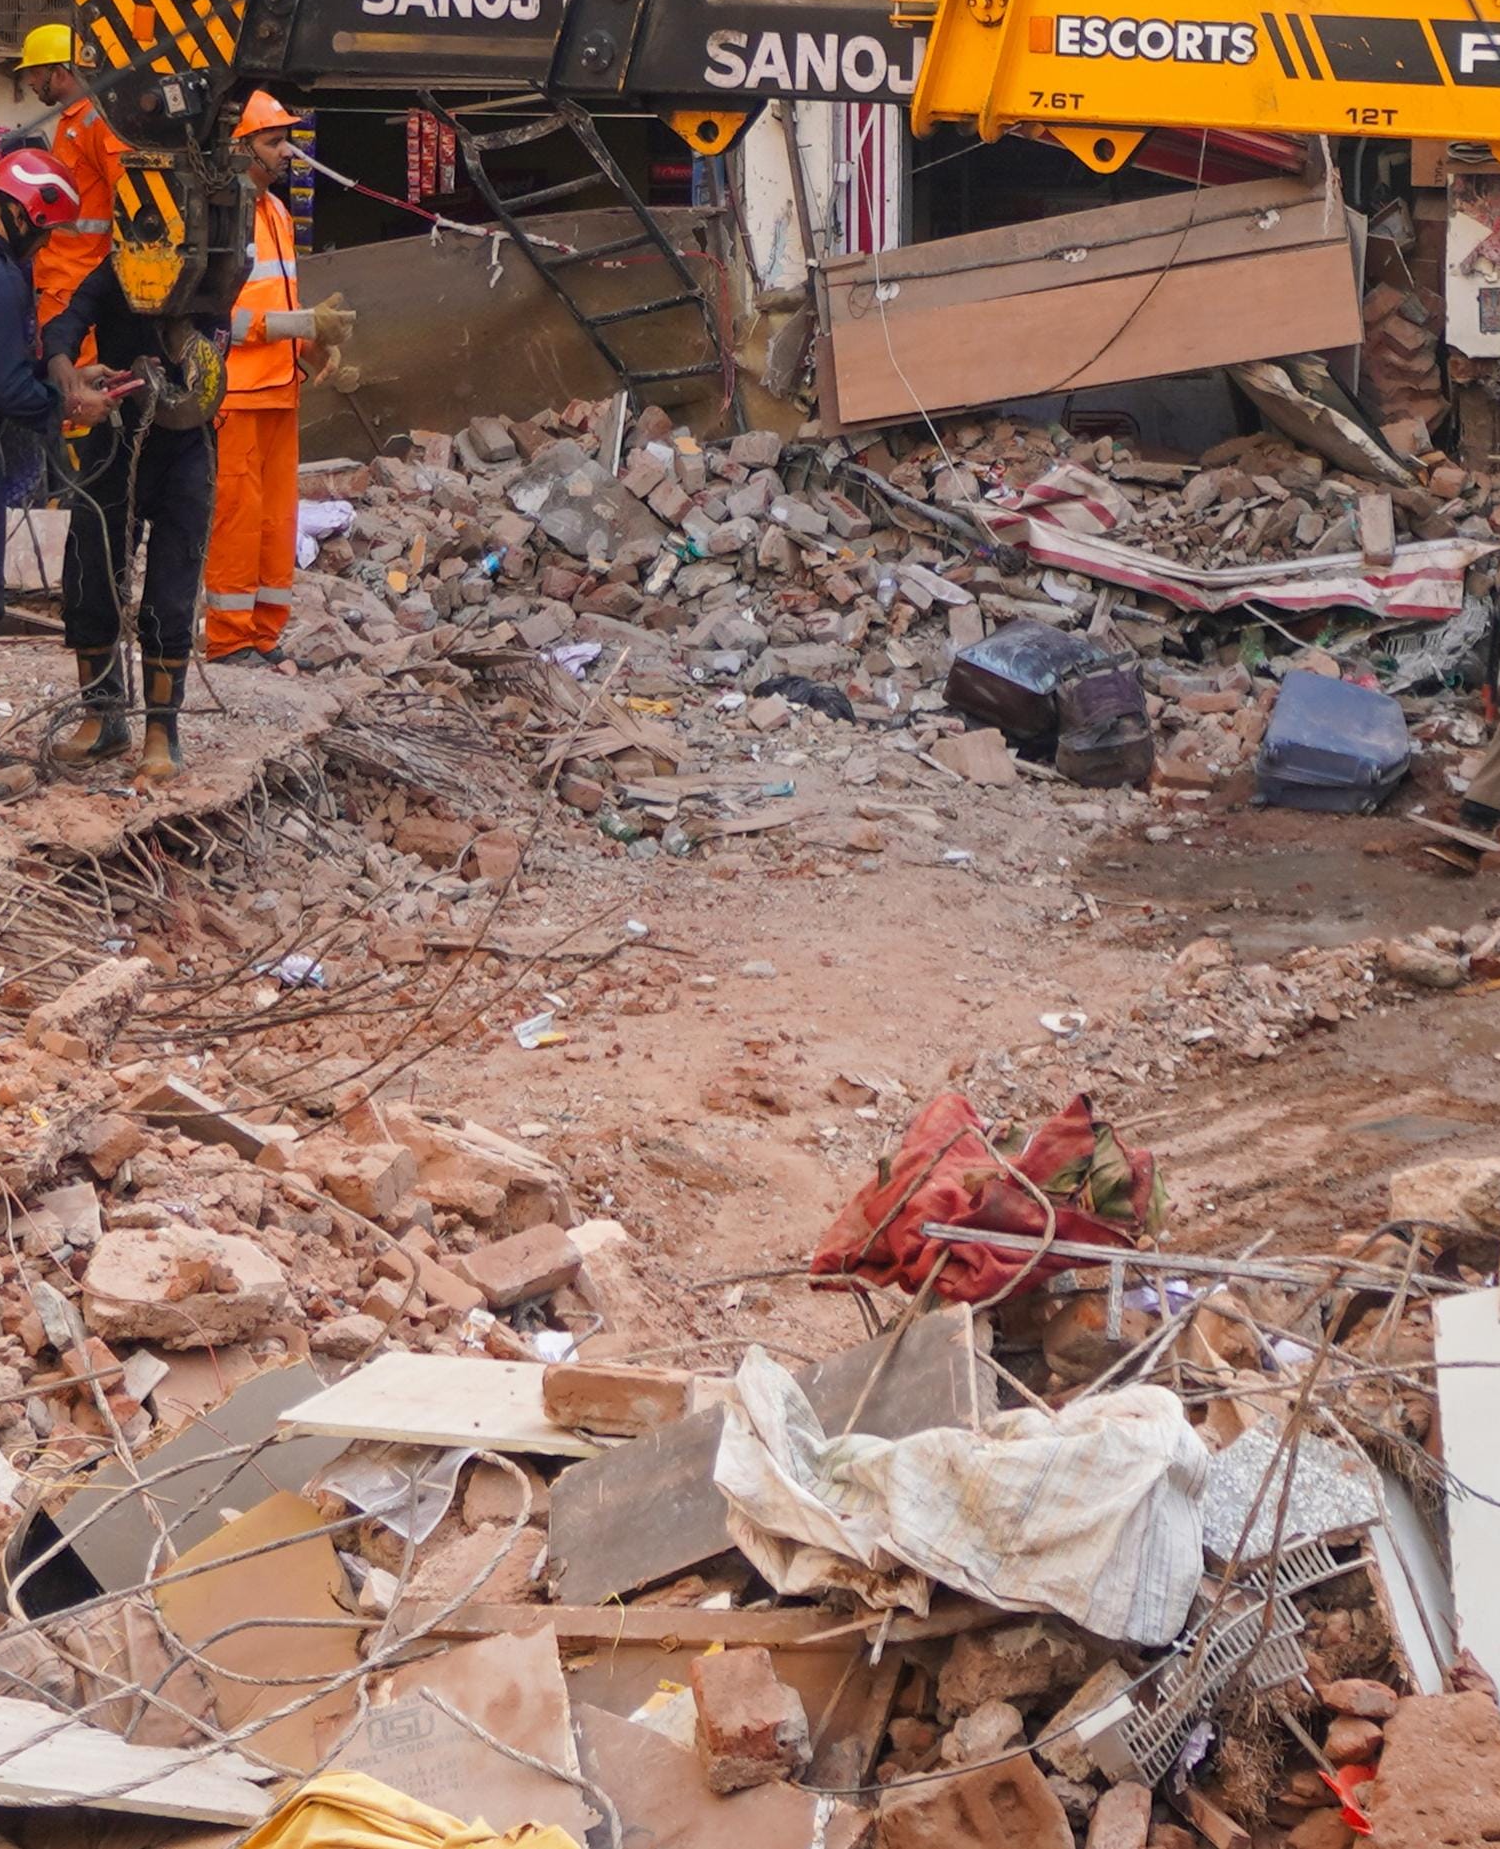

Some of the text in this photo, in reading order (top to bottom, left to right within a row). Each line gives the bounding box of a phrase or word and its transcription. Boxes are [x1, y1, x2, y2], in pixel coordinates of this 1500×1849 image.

[1057, 17, 1257, 65] ESCORTS
[703, 29, 928, 95] SANOJ
[1029, 92, 1085, 110] 7.6T
[1345, 108, 1399, 126] 12T
